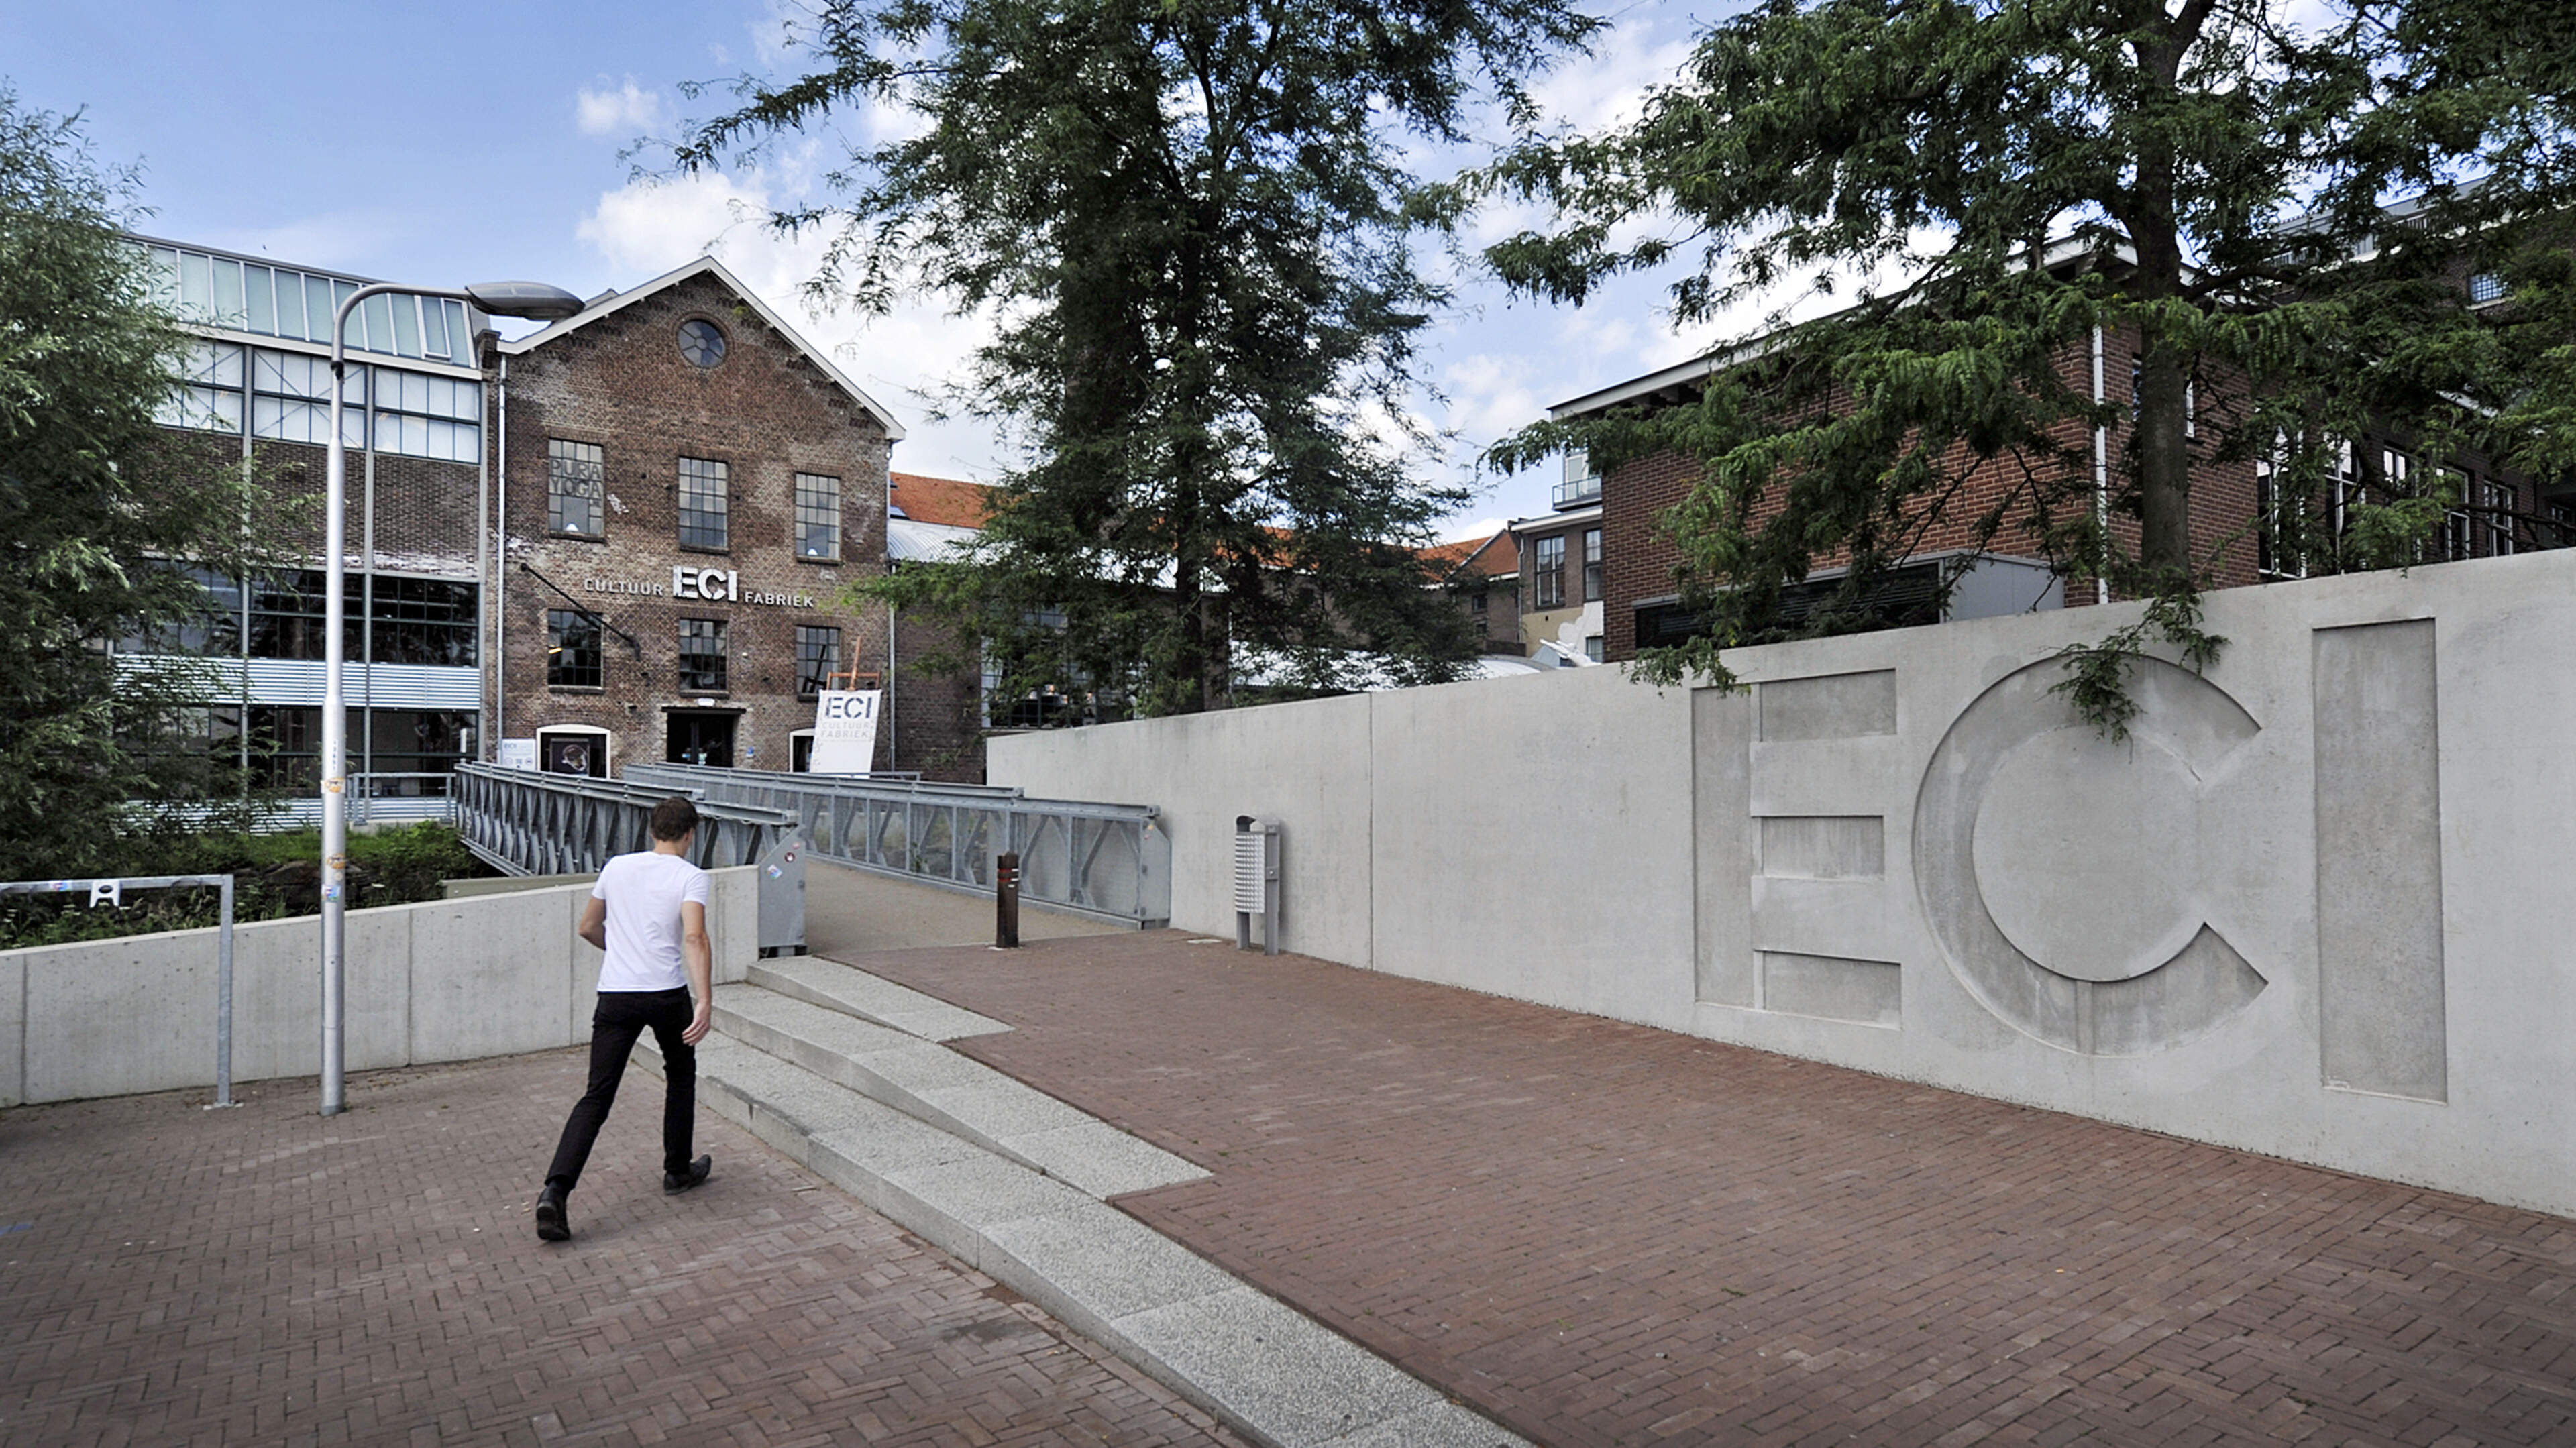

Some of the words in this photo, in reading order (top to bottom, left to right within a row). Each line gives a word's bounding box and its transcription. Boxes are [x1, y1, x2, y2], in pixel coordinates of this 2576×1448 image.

[584, 578, 663, 596] CULTUUR
[673, 565, 738, 602] ECI
[744, 590, 814, 608] FABRIEK
[825, 696, 873, 719] ECI
[820, 730, 868, 738] FABRIEK
[822, 721, 870, 730] CULTUUR
[1691, 617, 2448, 1105] ECI
